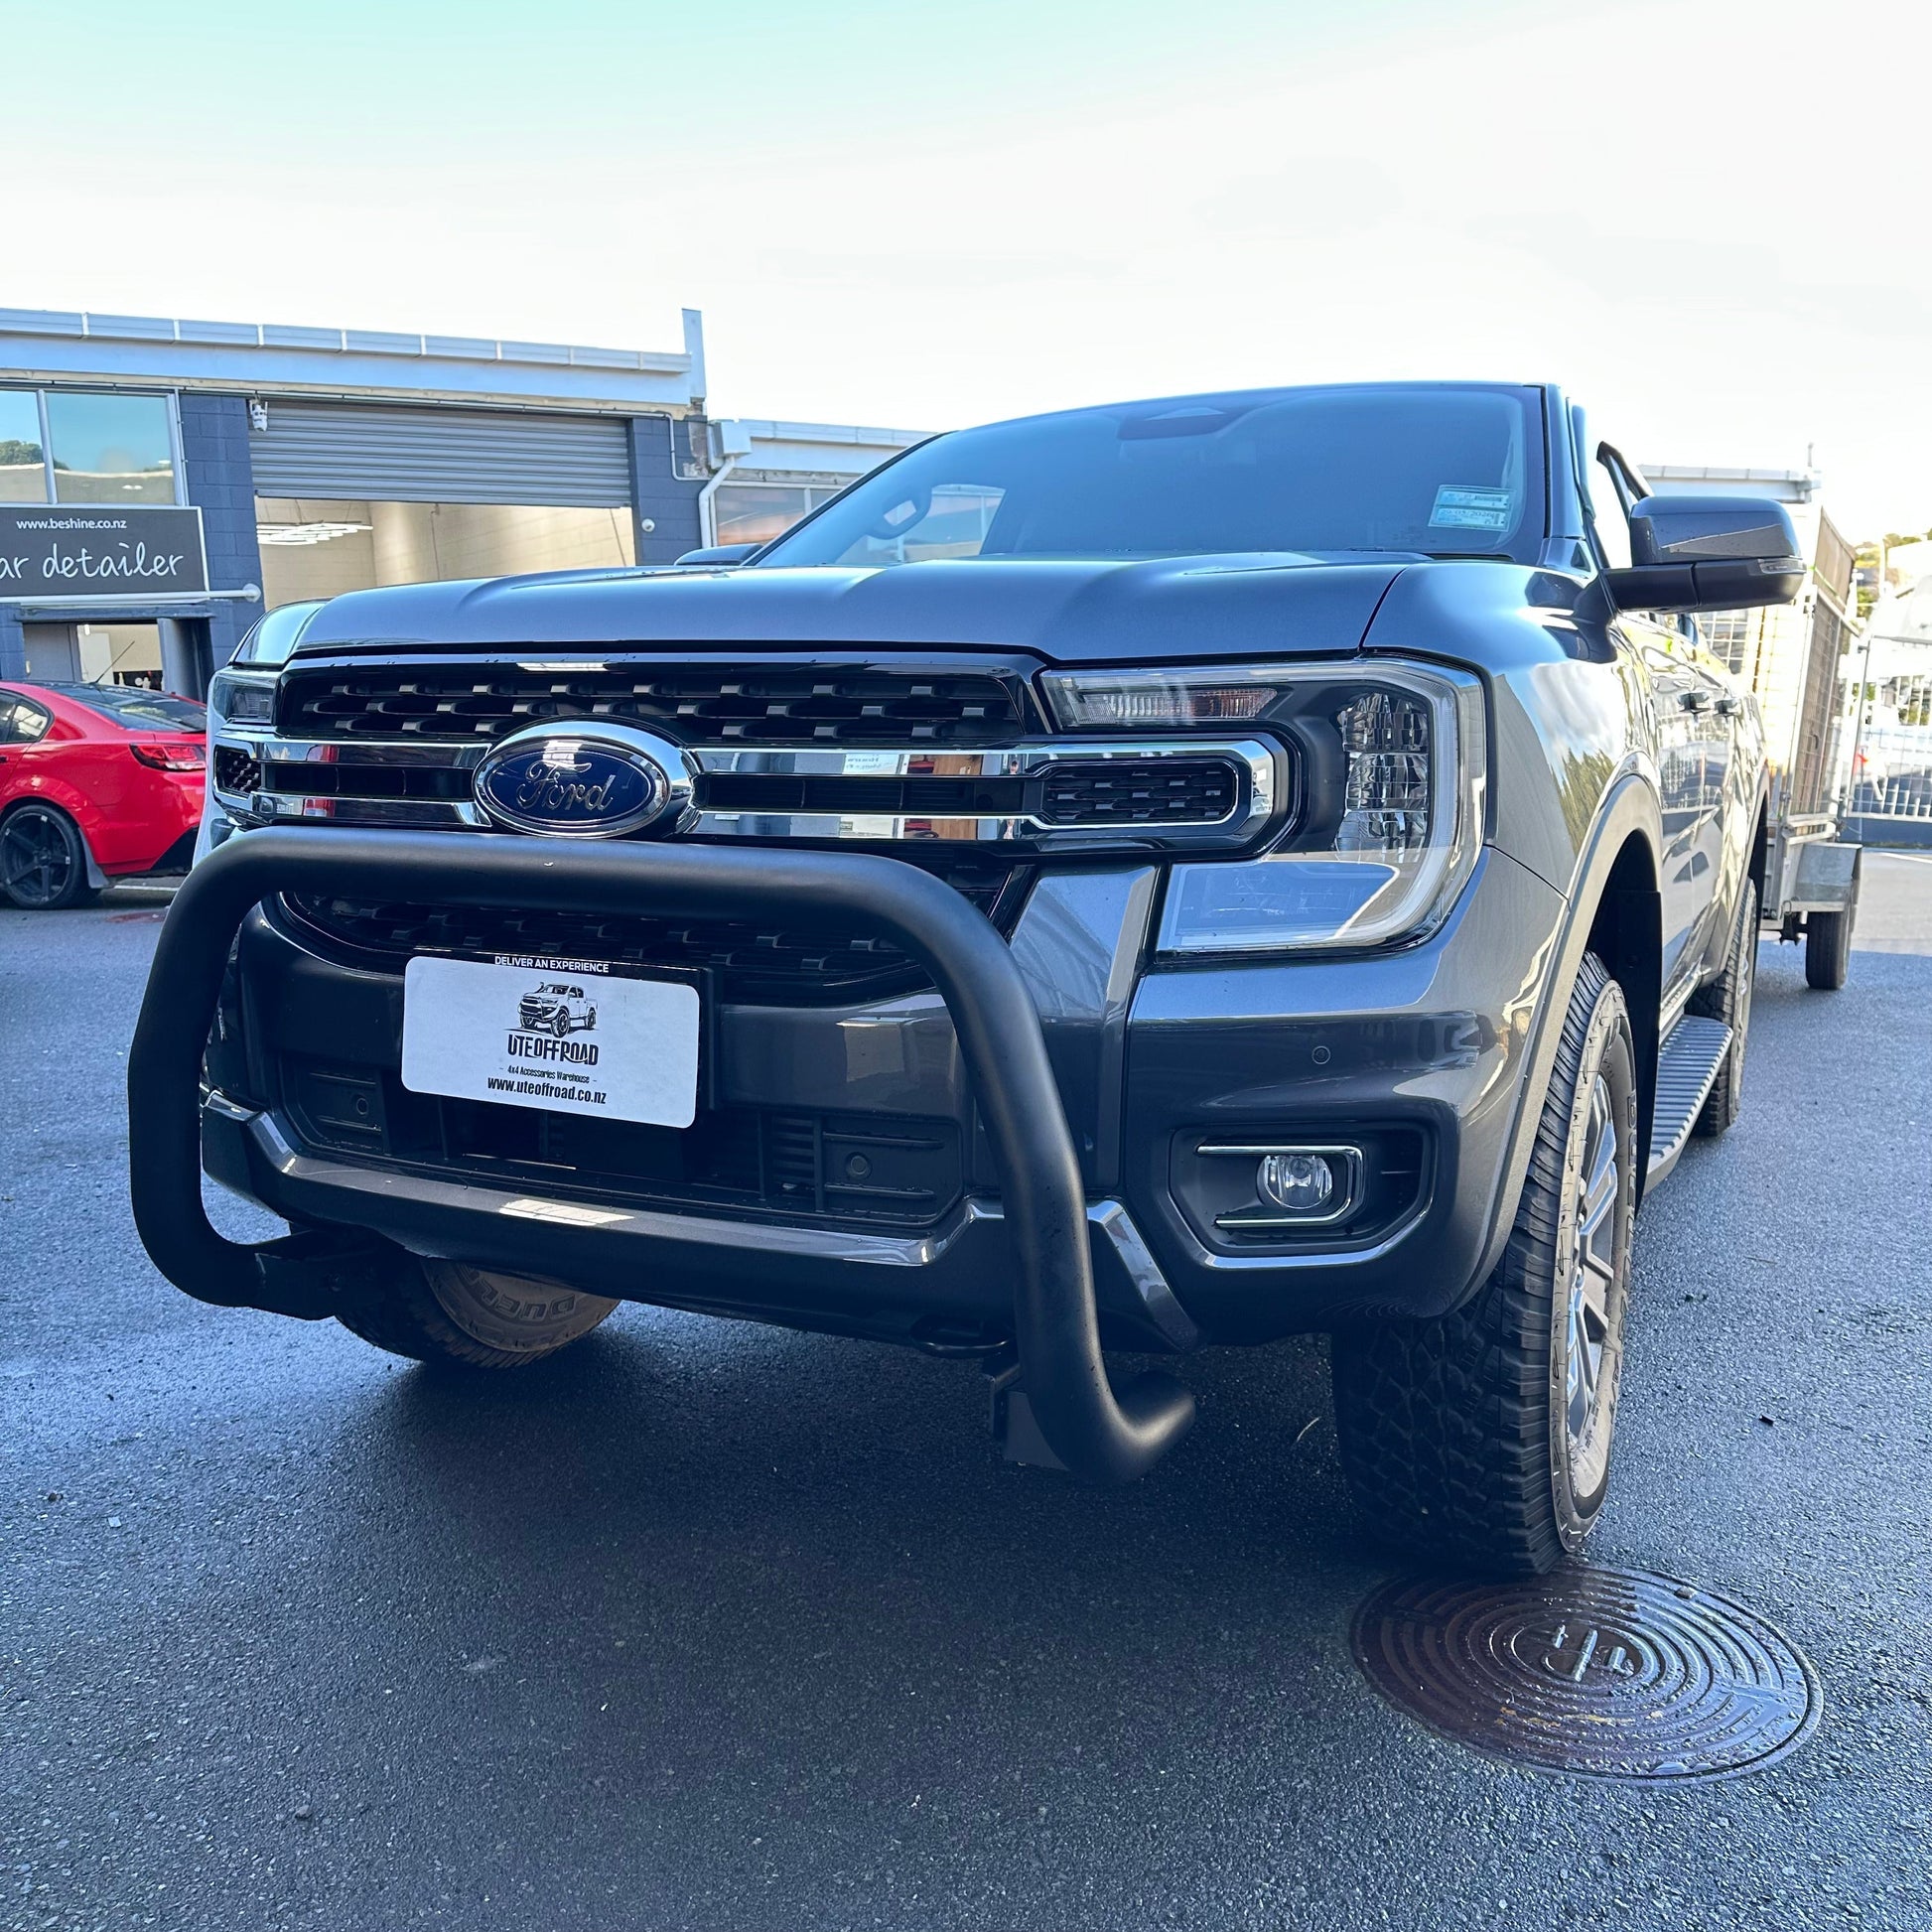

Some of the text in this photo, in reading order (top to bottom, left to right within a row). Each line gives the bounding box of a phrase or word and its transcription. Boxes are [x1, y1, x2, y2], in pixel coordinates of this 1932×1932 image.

[16, 517, 127, 529] www.beshine.co.nz
[42, 541, 185, 578] detailer
[516, 759, 618, 812] Ford
[494, 955, 610, 973] DELIVER AN EXPERIENCE
[507, 1034, 600, 1066] UTEOFFROAD
[507, 1064, 590, 1084] 4x4 Accessories Warehouse
[487, 1077, 607, 1104] www.uteoffroad.co.nz
